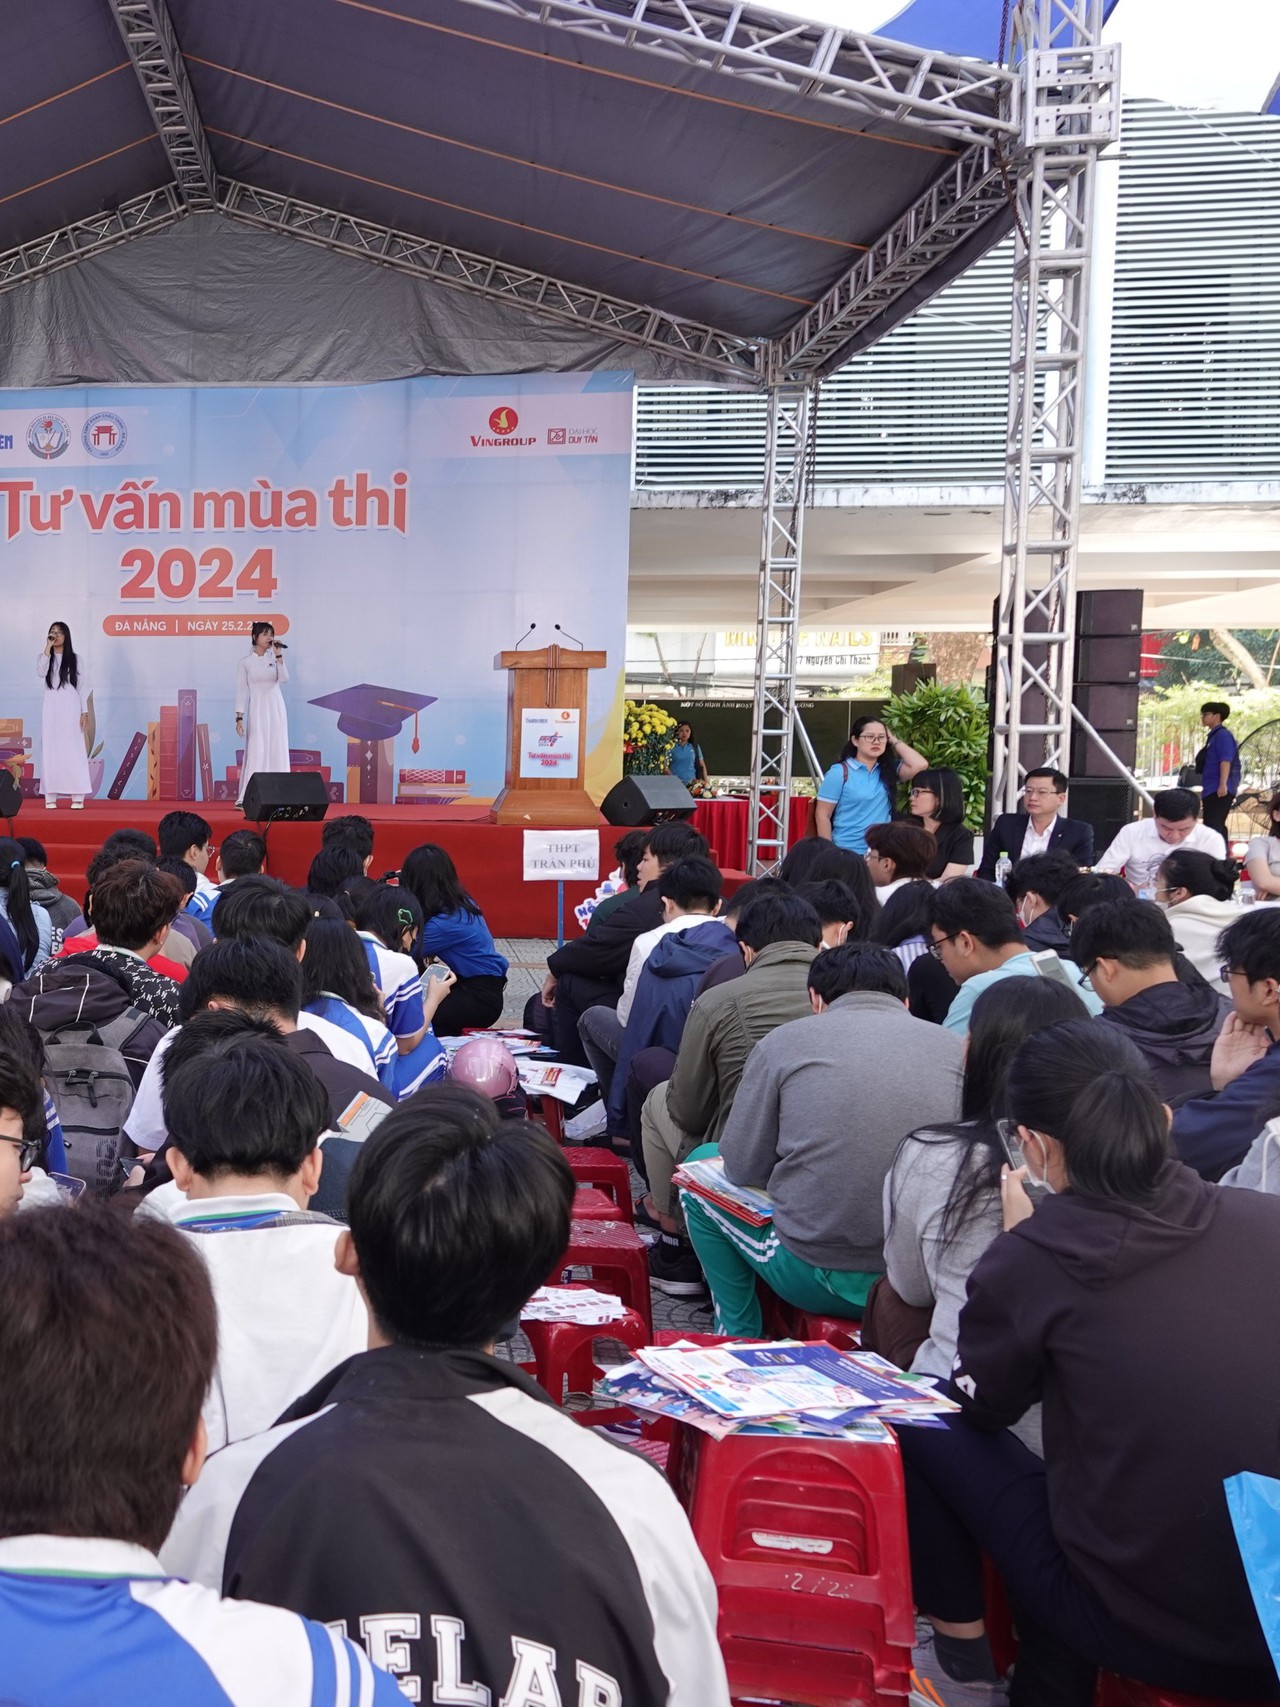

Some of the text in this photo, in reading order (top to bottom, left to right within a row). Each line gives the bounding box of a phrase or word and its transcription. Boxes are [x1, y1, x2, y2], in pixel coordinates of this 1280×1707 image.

[470, 435, 536, 447] VINGROUP
[568, 436, 583, 444] DUY
[80, 480, 181, 531] vấn
[194, 480, 317, 529] mùa
[328, 472, 409, 534] thi
[120, 548, 278, 600] 2024
[115, 619, 273, 631] ĐÀ NẴNG NGÀY 25.2.2
[546, 844, 580, 853] THPT
[570, 856, 596, 868] PHÚ
